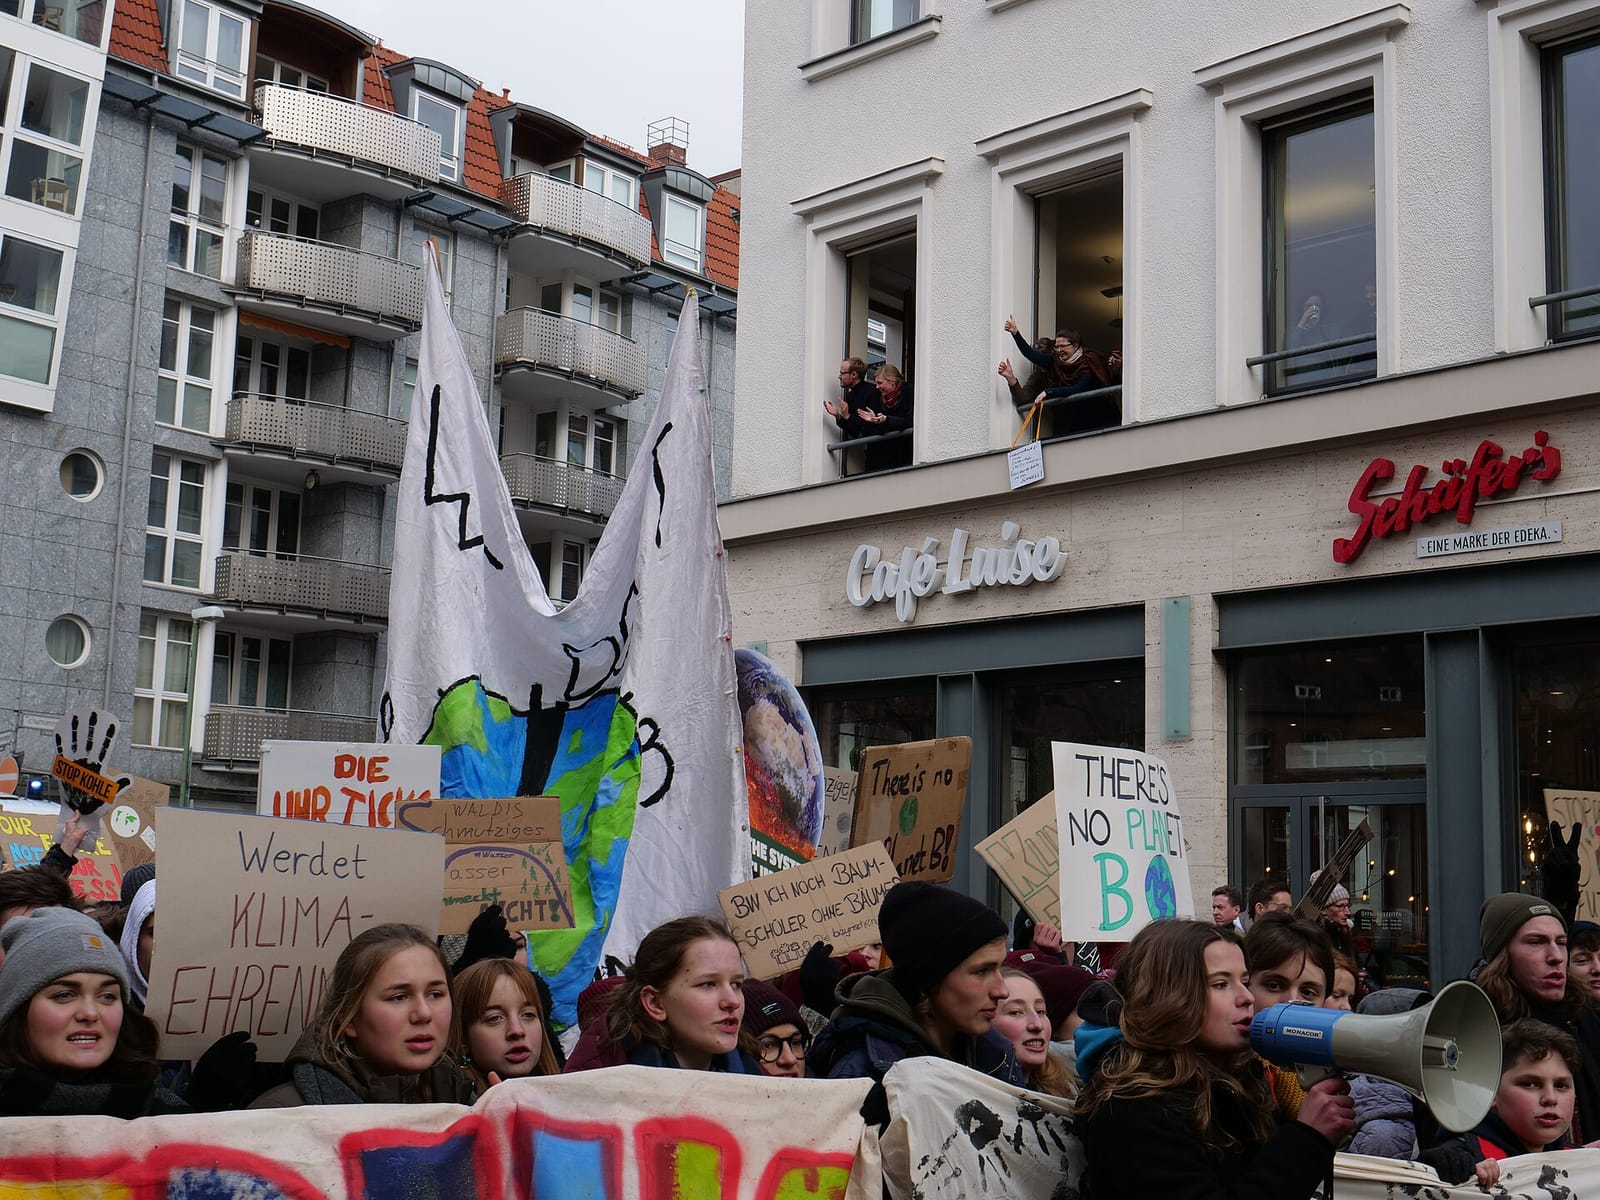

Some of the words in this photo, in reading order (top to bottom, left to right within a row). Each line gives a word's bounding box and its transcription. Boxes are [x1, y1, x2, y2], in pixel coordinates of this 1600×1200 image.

[1333, 430, 1562, 564] Schäfer's
[1427, 539, 1450, 553] EINE
[1453, 533, 1489, 550] MARKE
[1491, 531, 1511, 546] DER
[847, 537, 944, 623] Café
[942, 521, 1067, 596] Luise
[56, 759, 80, 783] STOP
[79, 771, 113, 799] KOHLE
[334, 754, 390, 784] DIE
[872, 758, 910, 798] There
[911, 762, 926, 794] is
[933, 768, 953, 787] no
[1076, 754, 1169, 806] THERE'S
[8, 841, 46, 863] NOT
[238, 831, 368, 880] Werdet
[1069, 808, 1111, 846] NO
[1126, 808, 1183, 859] PLANET
[766, 883, 788, 905] ICH
[790, 873, 826, 899] NOCH
[831, 857, 886, 886] BAUM-
[1093, 852, 1134, 932] B
[230, 892, 375, 949] KLIMA-
[744, 912, 809, 948] SCHÜLER
[811, 902, 844, 924] OHNE
